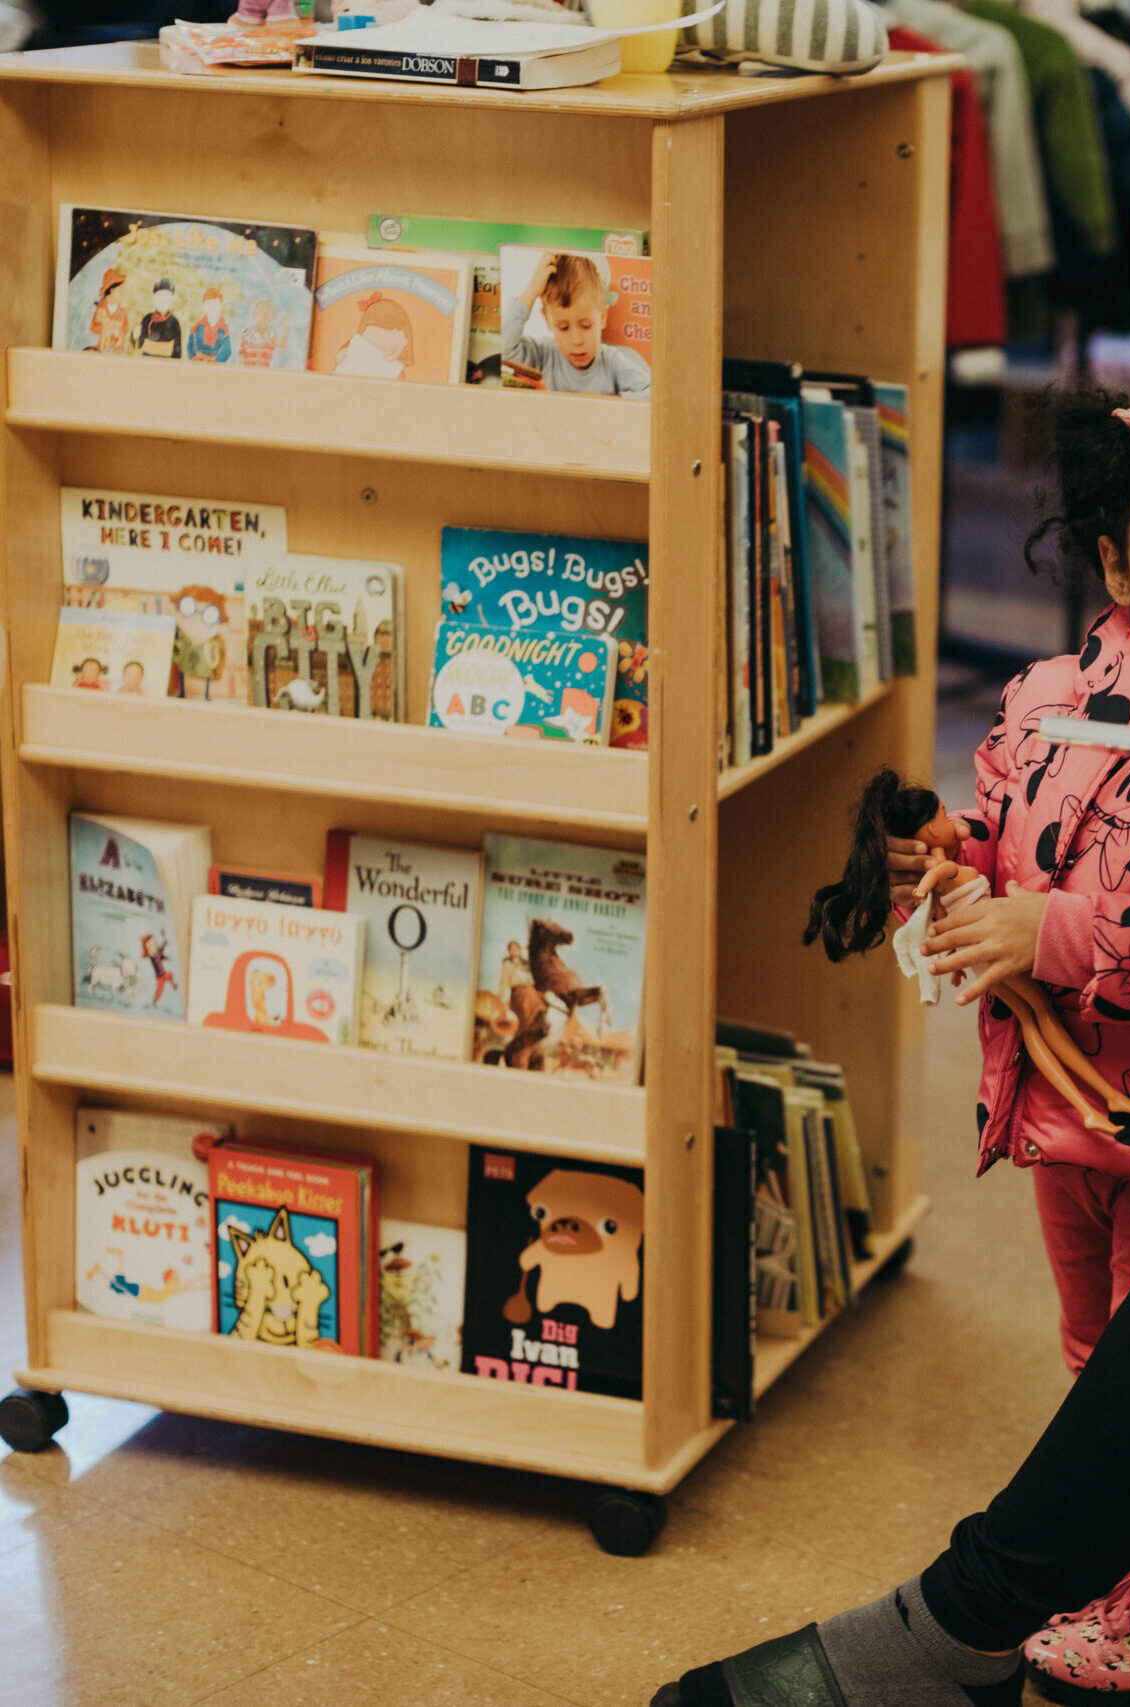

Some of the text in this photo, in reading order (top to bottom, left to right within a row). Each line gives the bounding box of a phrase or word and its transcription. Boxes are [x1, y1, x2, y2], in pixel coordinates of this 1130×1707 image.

[401, 56, 456, 74] DOBSON
[619, 276, 651, 294] Cho
[631, 302, 651, 316] an
[623, 322, 652, 339] Che
[82, 498, 266, 539] KINDERGARTEN,
[101, 526, 243, 556] HERE I COME!
[468, 548, 650, 598] Bugs! Bugs!
[262, 597, 346, 650] BIG
[498, 589, 625, 633] Bugs!
[445, 631, 583, 667] GOODNIGHT
[100, 837, 122, 869] A
[384, 851, 412, 876] The
[354, 864, 470, 911] Wonderful
[491, 871, 640, 904] SURE SHOT
[530, 867, 602, 885] LITTLE
[388, 904, 427, 951] O
[541, 1318, 579, 1345] Dig
[511, 1328, 579, 1369] Ivan
